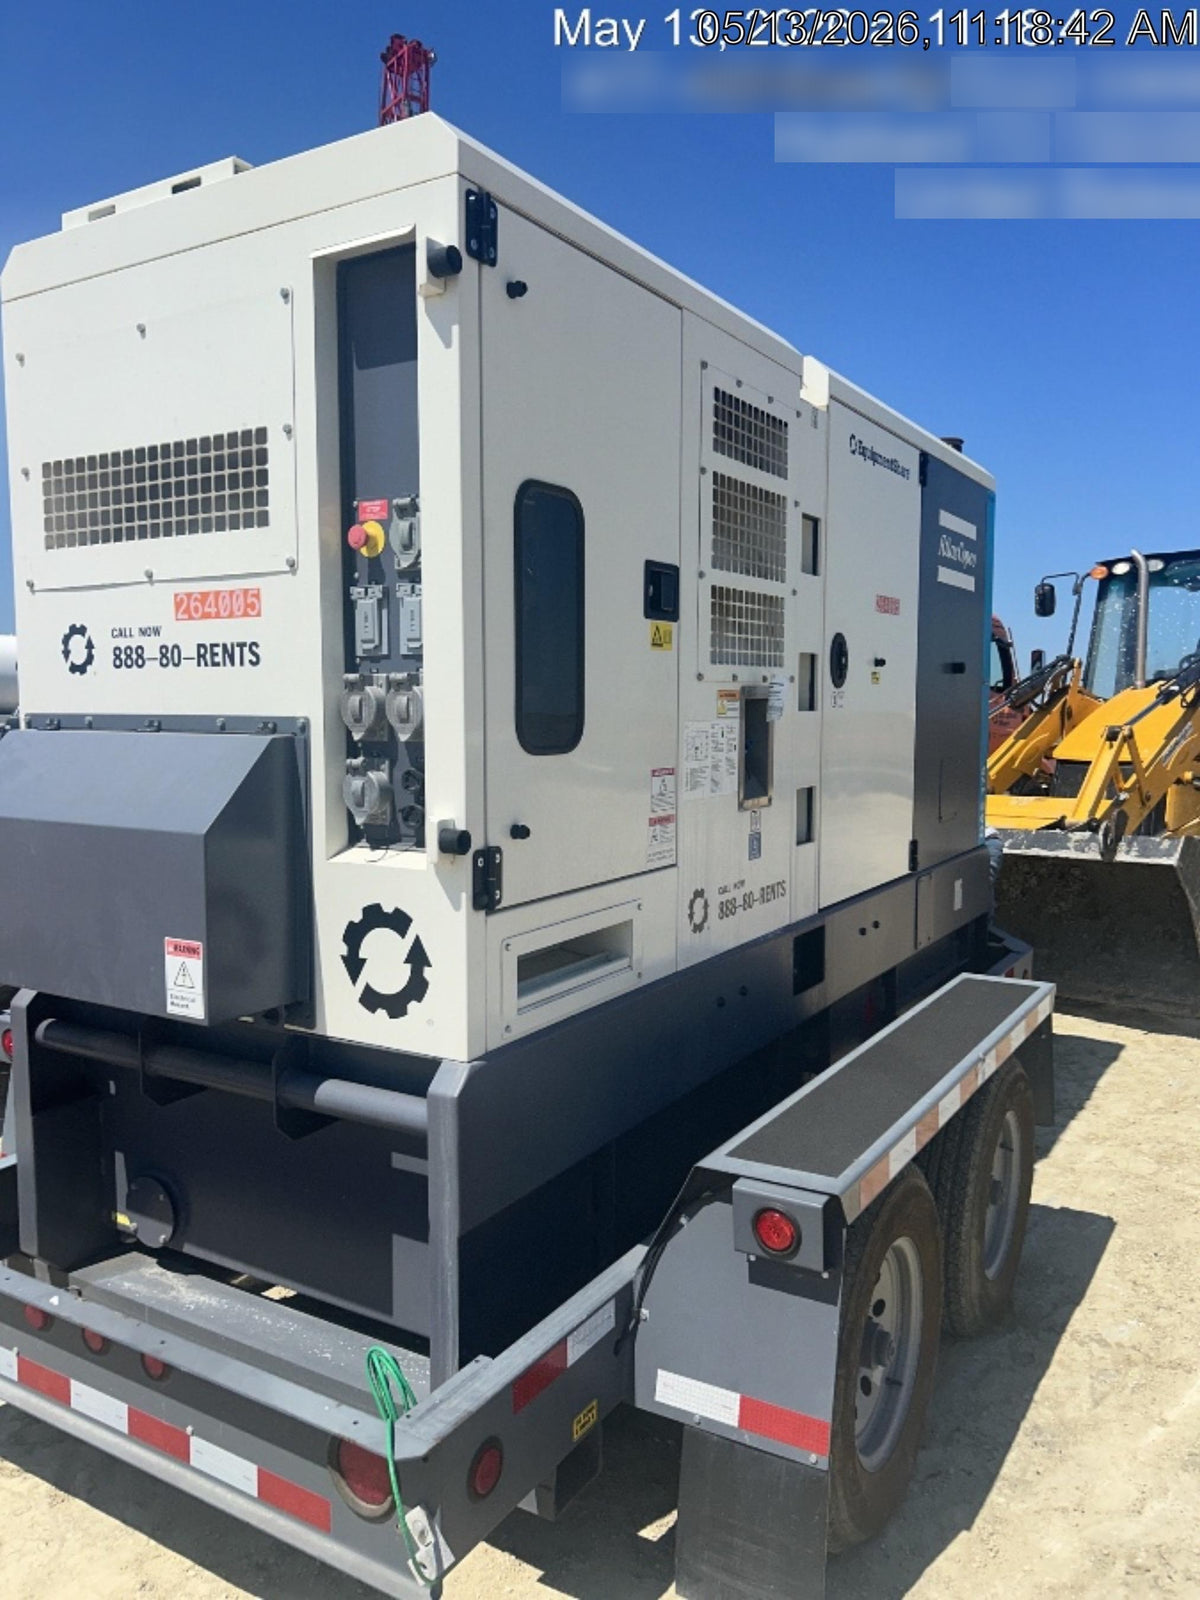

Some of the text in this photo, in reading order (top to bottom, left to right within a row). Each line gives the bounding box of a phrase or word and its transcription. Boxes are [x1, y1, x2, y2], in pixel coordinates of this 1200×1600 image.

[176, 588, 261, 619] 264005
[111, 626, 162, 639] CALL NOW
[112, 641, 261, 669] 888-80-RENTS
